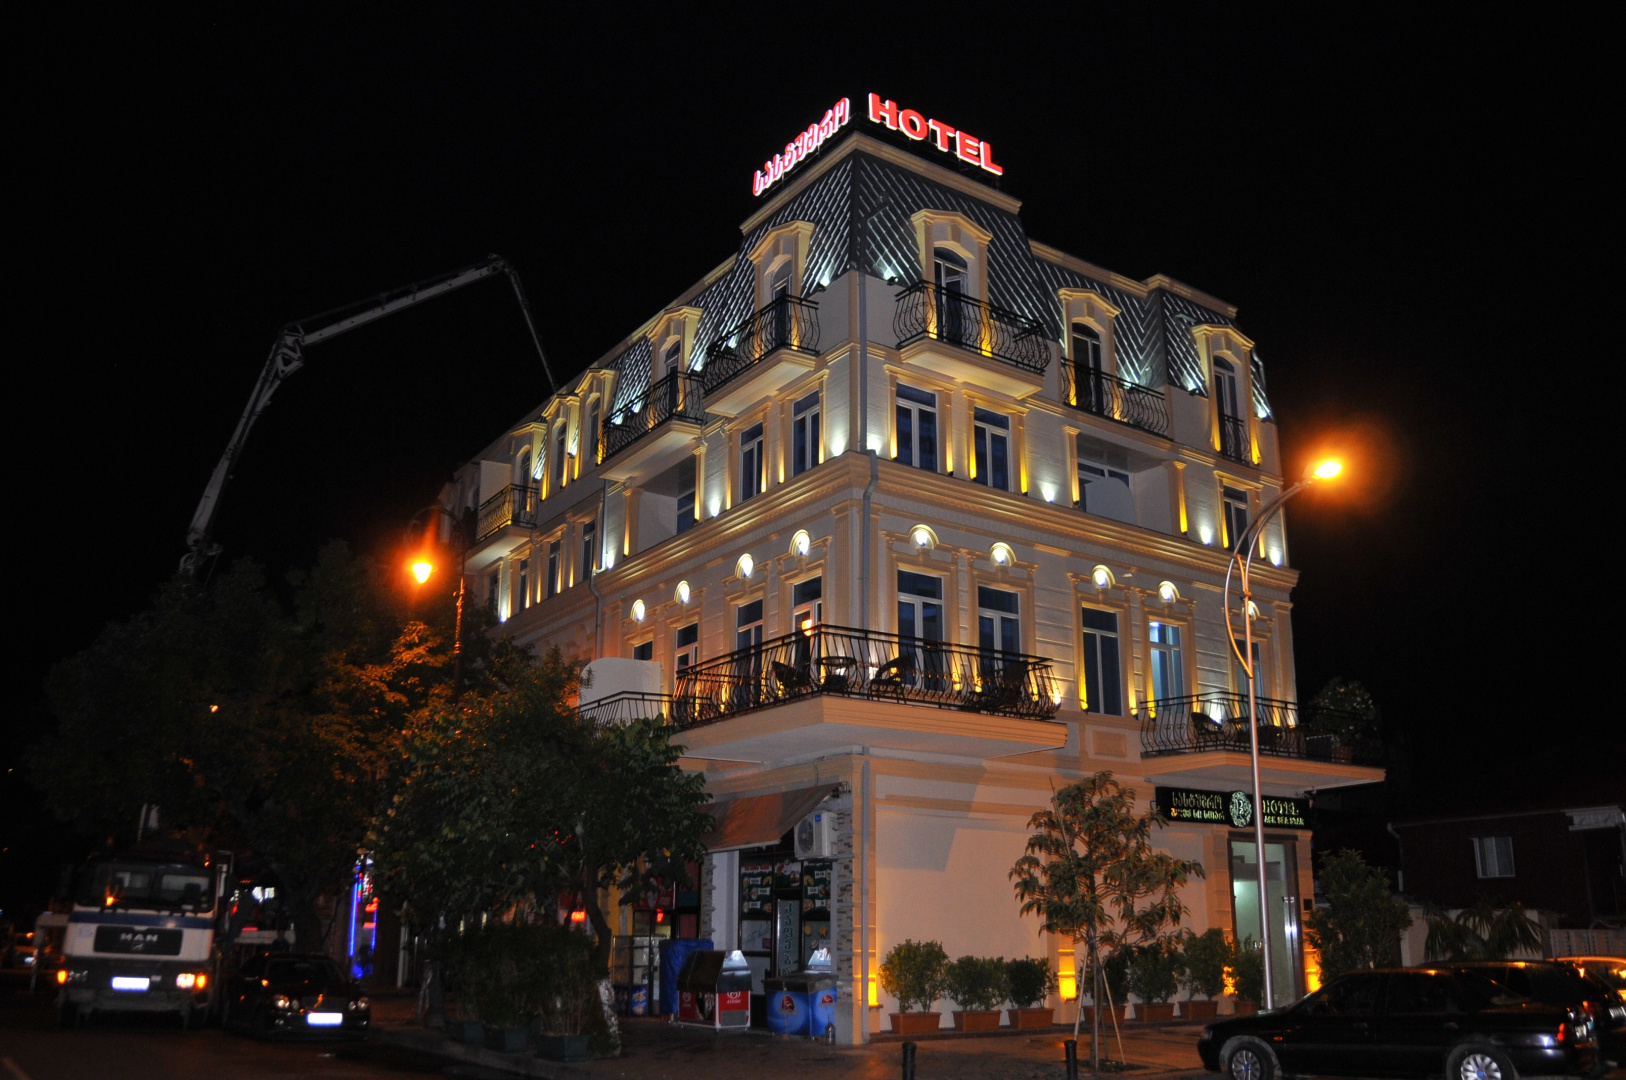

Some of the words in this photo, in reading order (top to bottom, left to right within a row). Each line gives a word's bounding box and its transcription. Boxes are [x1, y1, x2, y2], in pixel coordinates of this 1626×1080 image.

[752, 97, 850, 196] სასტუმრო
[868, 92, 1003, 175] HOTEL
[1262, 799, 1299, 815] HOTEL
[120, 932, 159, 942] MAN
